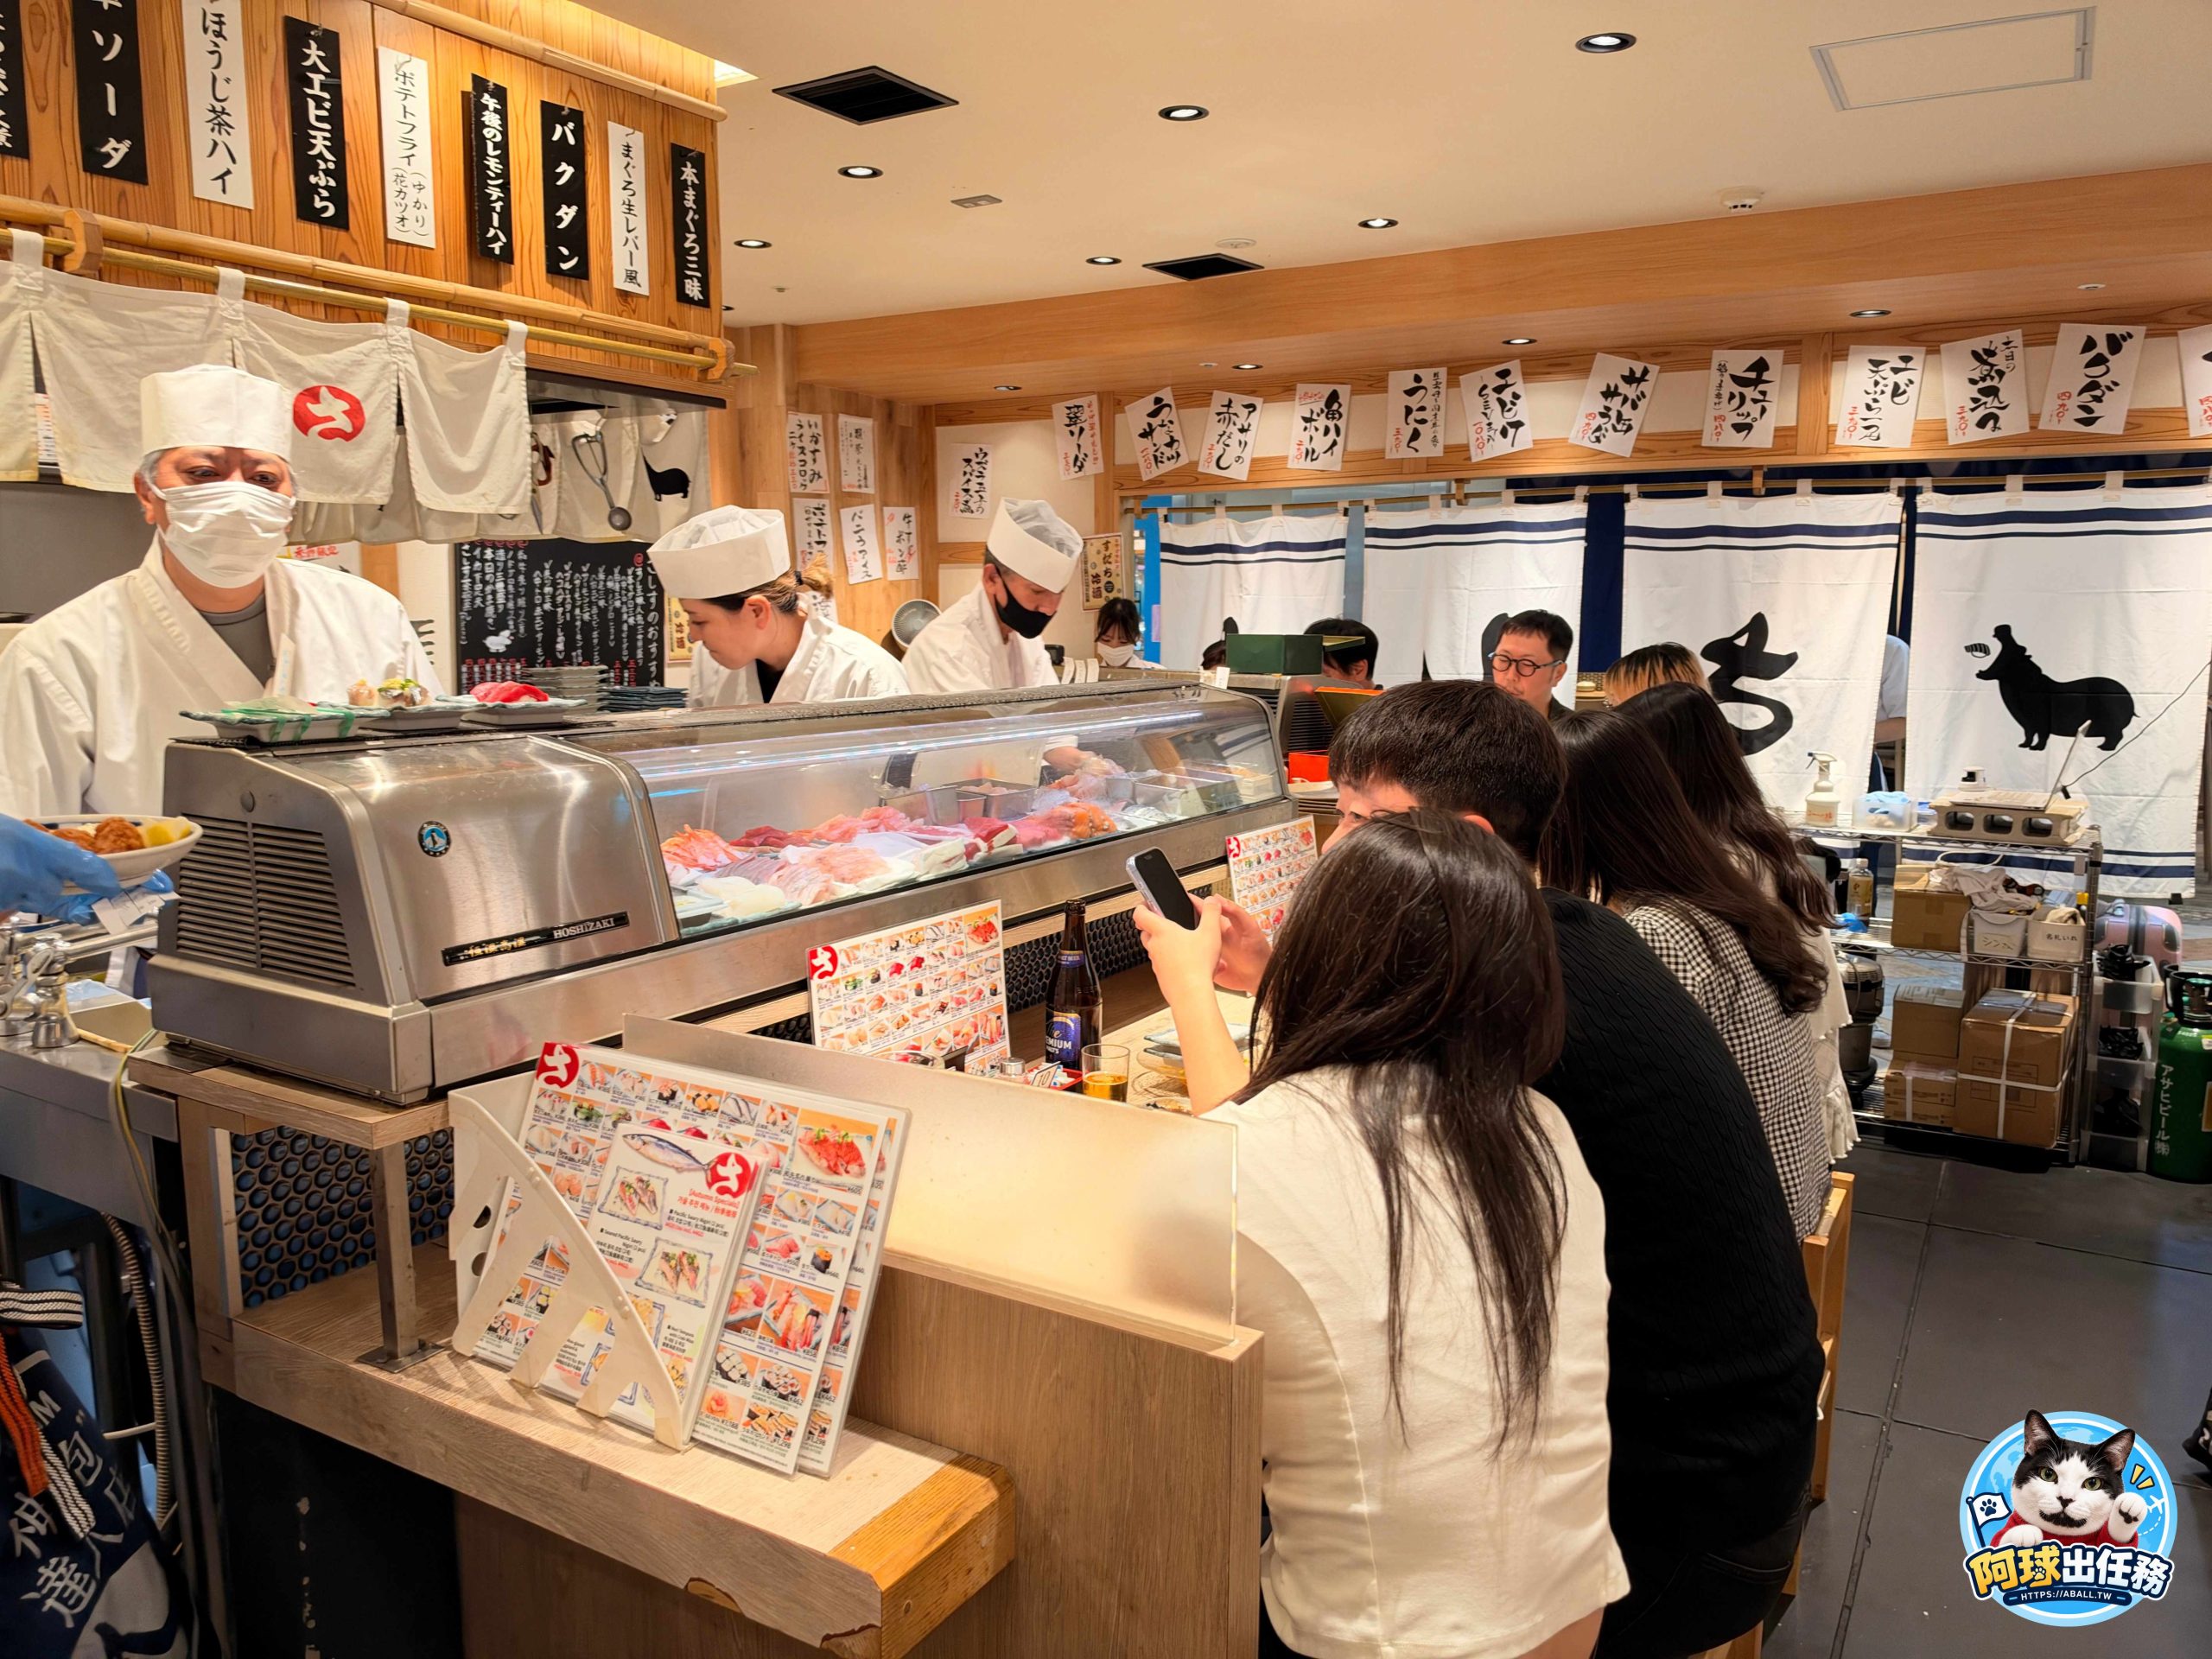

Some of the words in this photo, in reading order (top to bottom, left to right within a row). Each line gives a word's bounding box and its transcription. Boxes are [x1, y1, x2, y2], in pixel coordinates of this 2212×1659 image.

[202, 7, 237, 194] ほうじ茶ハイ
[301, 41, 338, 219] 大エビ天ぷら
[394, 71, 417, 167] ポテトフライ
[480, 92, 506, 256] 午後のレモンティーハイ
[550, 121, 580, 271] バクダン
[620, 142, 642, 289] まぐろ生レバー風
[1403, 373, 1428, 453] うにく
[1890, 355, 1918, 405] エビ
[2074, 331, 2133, 427] バクダン
[1215, 397, 1241, 471] 赤だし
[553, 918, 615, 940] HOSHIZAKI
